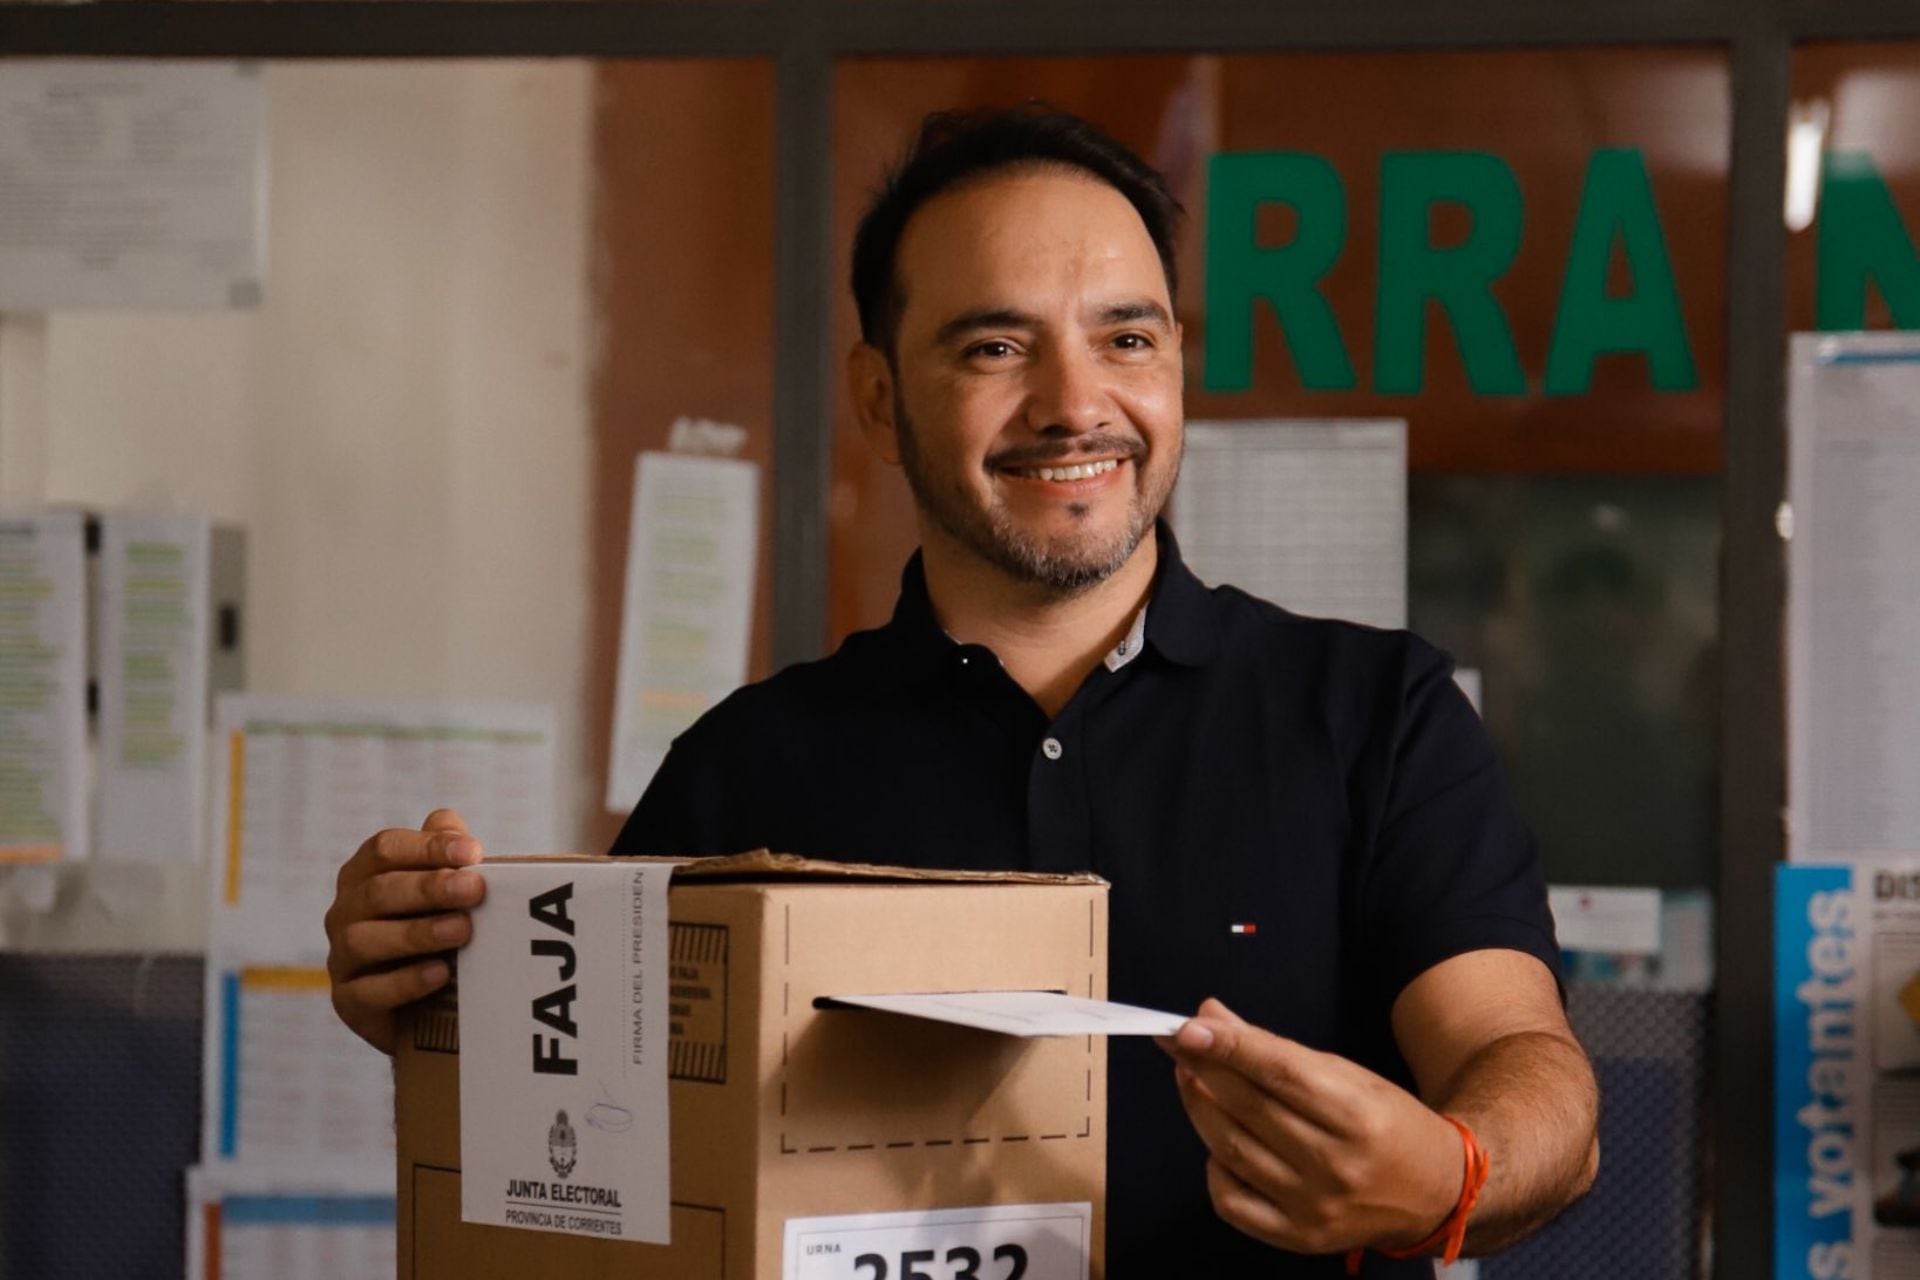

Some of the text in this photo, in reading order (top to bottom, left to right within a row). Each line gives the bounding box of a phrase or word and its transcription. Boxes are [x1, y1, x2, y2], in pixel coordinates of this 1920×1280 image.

[529, 881, 578, 1077] FAJA
[632, 969, 644, 1005] DEL
[632, 1007, 644, 1067] FIRMA
[1796, 890, 1857, 1219] votantes
[506, 1179, 622, 1208] JUNTA ELECTORAL
[505, 1209, 623, 1236] PROVINCIA DE CORRIENTES
[806, 1244, 842, 1256] URNA
[853, 1243, 1029, 1280] 2532
